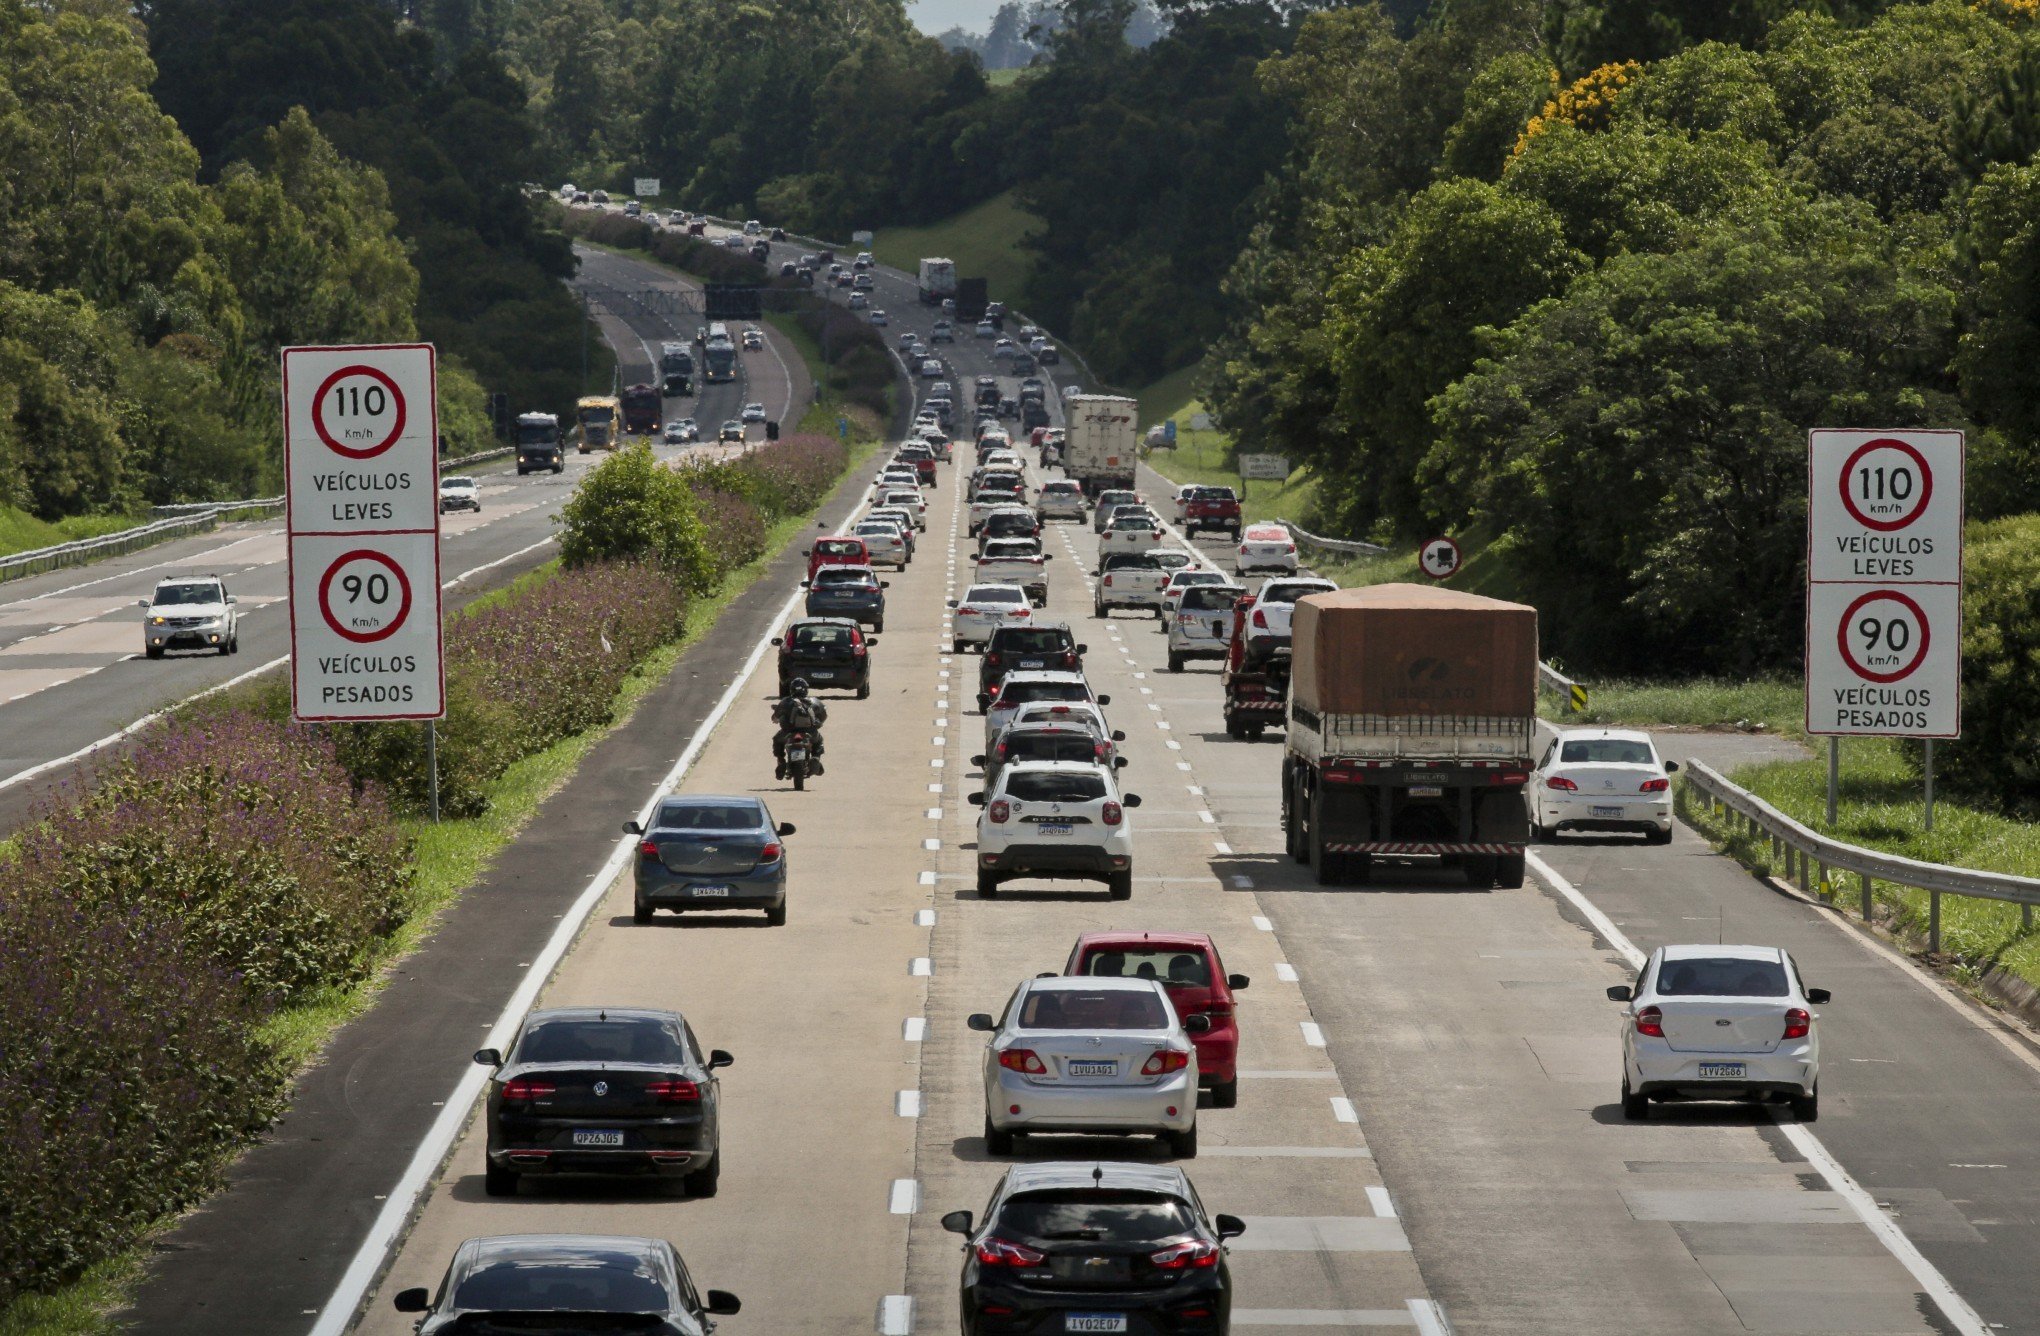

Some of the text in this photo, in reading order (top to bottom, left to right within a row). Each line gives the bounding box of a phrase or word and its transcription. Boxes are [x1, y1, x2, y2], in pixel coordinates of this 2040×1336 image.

[335, 385, 387, 417] 110
[313, 471, 411, 492] VEÍCULOS
[1860, 467, 1913, 500] 110
[332, 503, 393, 520] LEVES
[1870, 503, 1903, 514] km/h
[1837, 532, 1934, 554] VEÍCULOS
[1854, 559, 1914, 576] LEVES
[342, 573, 389, 605] 90
[1859, 617, 1909, 652] 90
[319, 654, 416, 675] VEÍCULOS
[1867, 654, 1900, 666] km/h
[322, 685, 414, 703] PESADOS
[1834, 684, 1931, 706] VEÍCULOS
[1836, 709, 1928, 728] PESADOS
